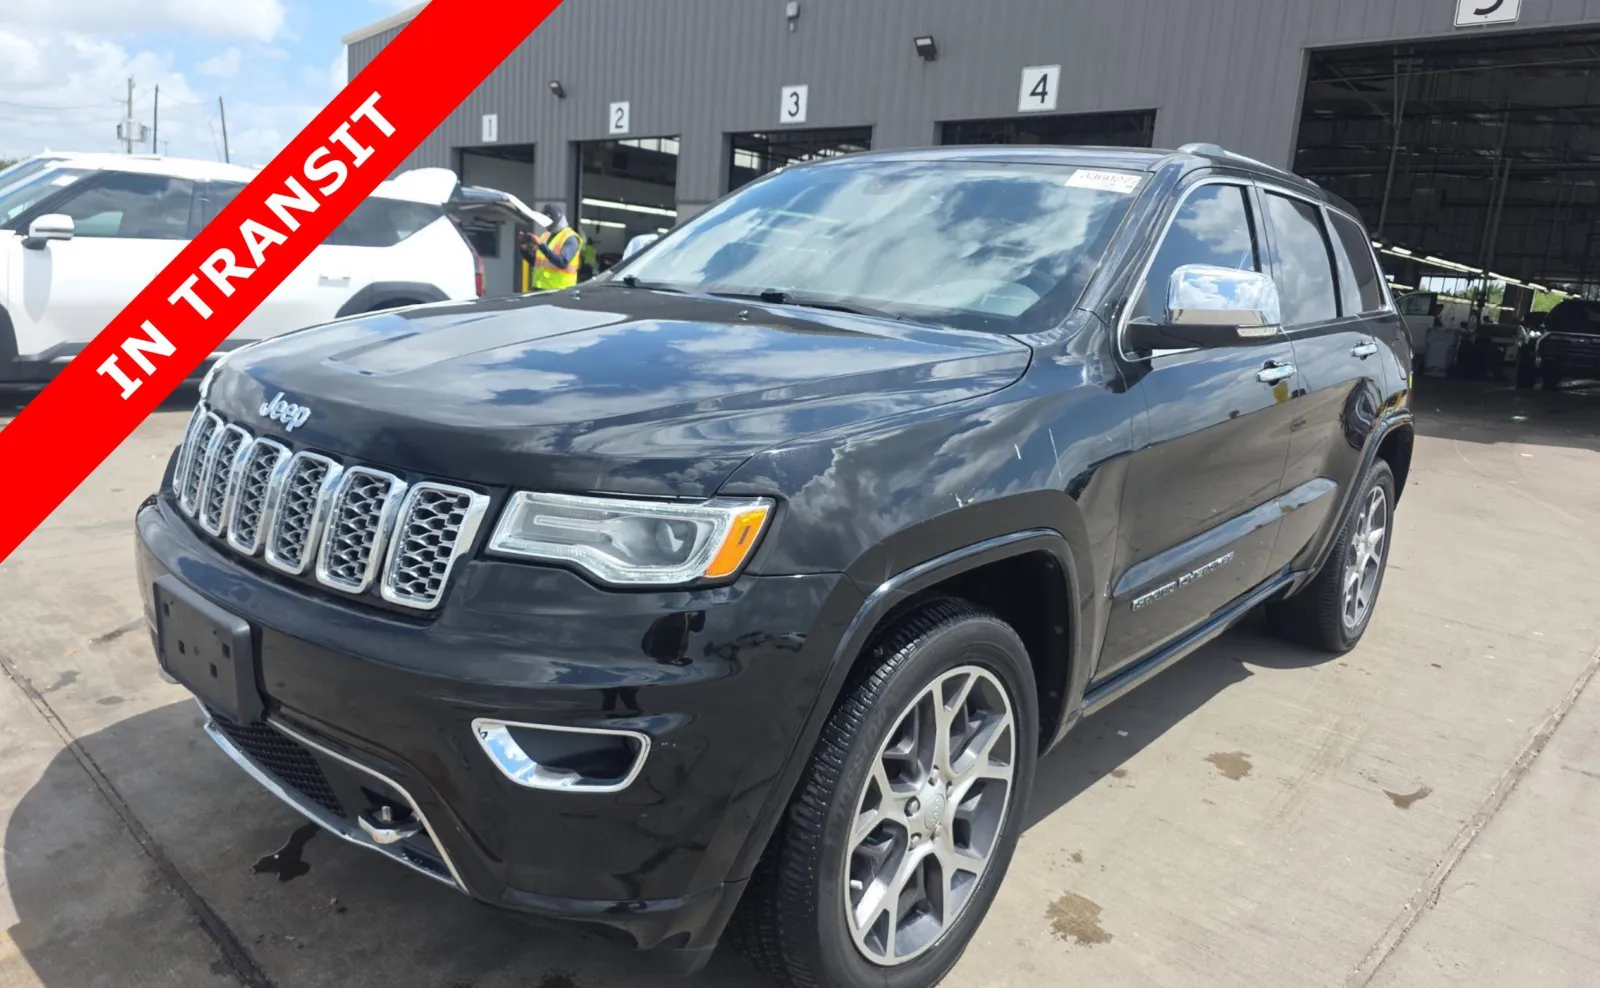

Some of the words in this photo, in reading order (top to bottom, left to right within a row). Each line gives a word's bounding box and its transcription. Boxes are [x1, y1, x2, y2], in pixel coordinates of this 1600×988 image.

[1029, 73, 1048, 104] 4
[614, 106, 625, 130] 2
[787, 91, 800, 118] 3
[487, 118, 493, 139] 1
[258, 391, 311, 432] Jeep
